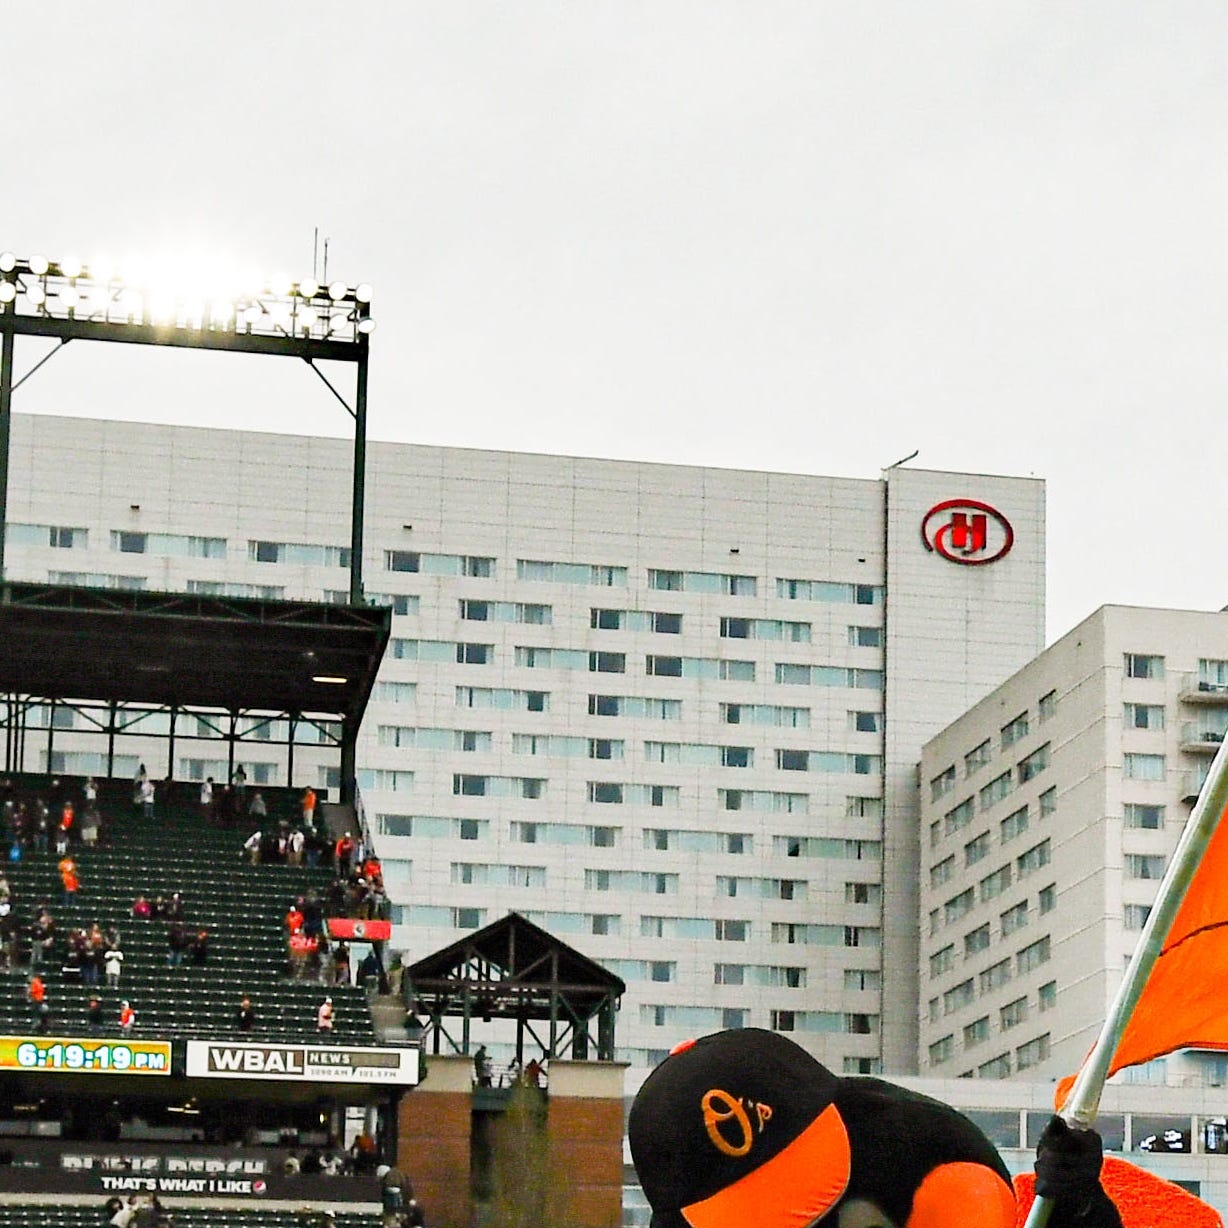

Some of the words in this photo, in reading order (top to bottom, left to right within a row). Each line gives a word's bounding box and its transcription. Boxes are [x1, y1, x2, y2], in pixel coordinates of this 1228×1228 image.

[18, 1042, 132, 1069] 6:19:19
[135, 1053, 165, 1068] PM
[211, 1049, 303, 1072] WBAL
[309, 1053, 350, 1064] NEWS
[702, 1089, 772, 1155] O's
[101, 1177, 156, 1191] THAT'S
[159, 1179, 206, 1192] WHAT
[209, 1181, 215, 1192] I
[218, 1181, 251, 1193] LIKE
